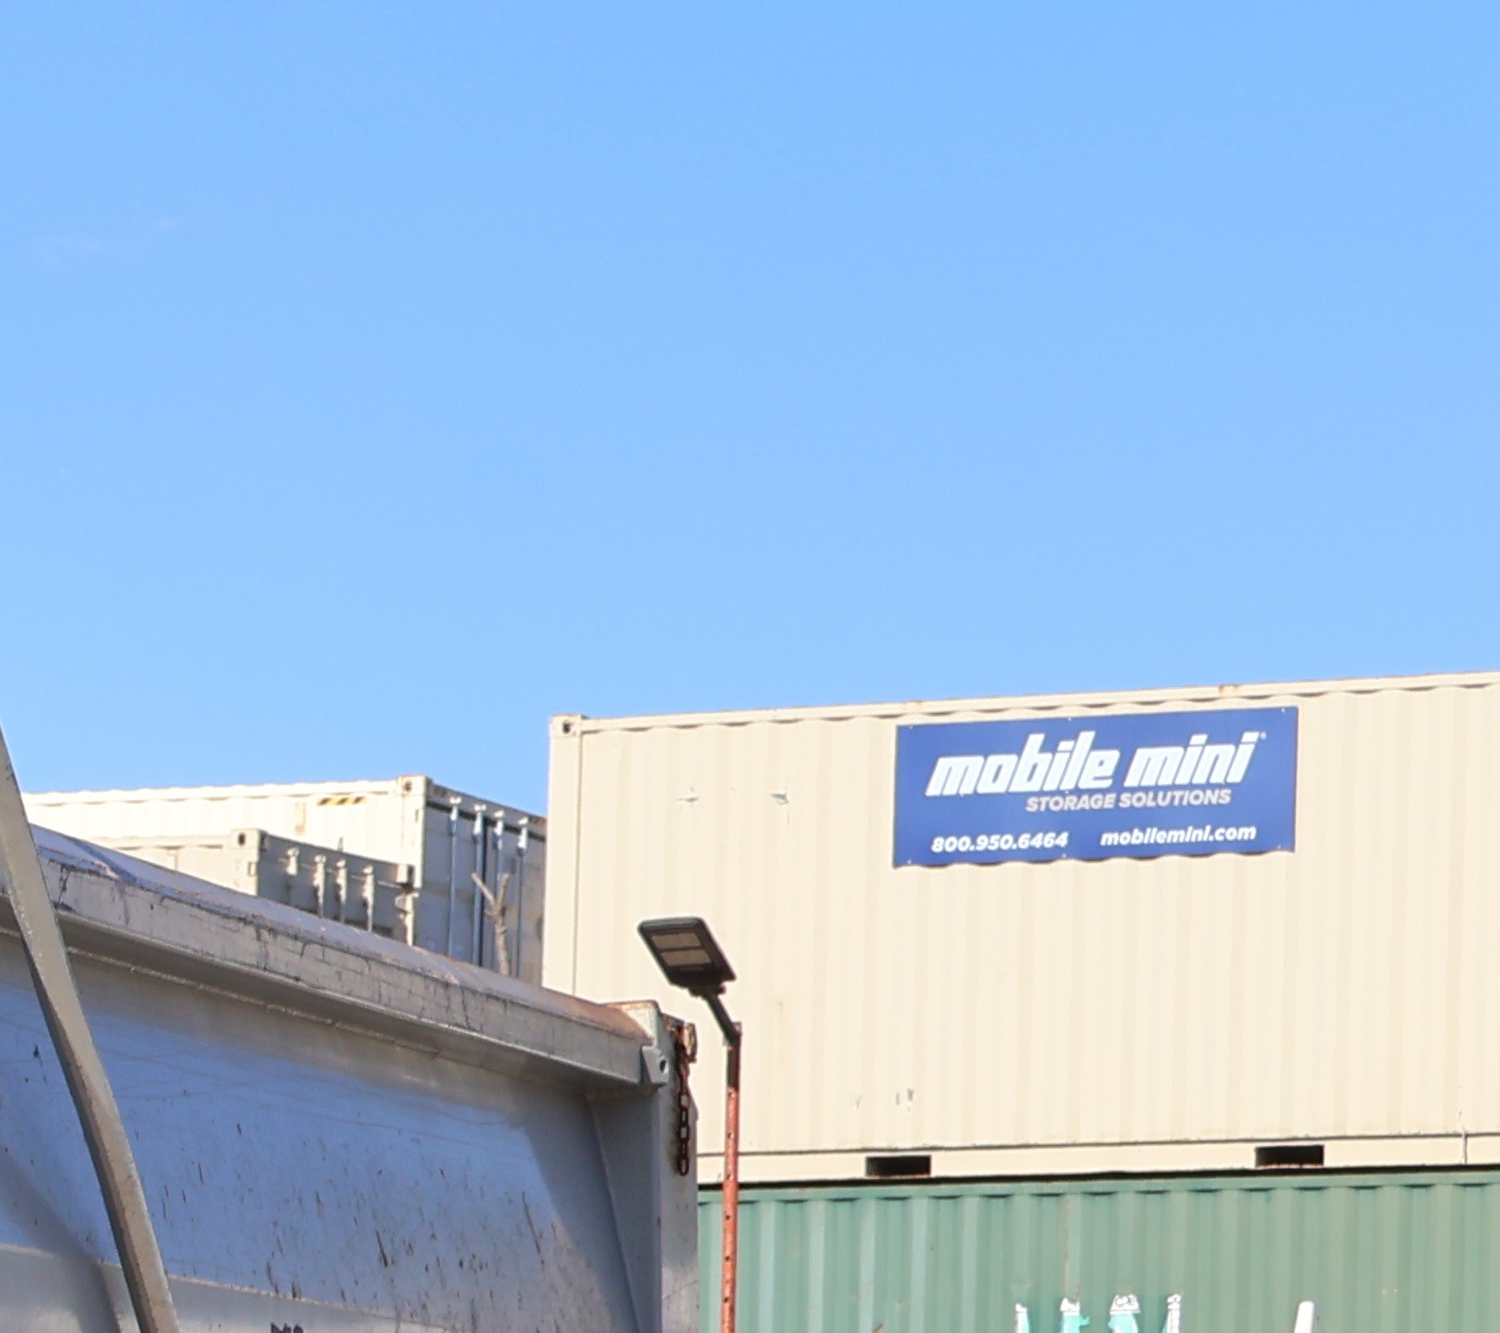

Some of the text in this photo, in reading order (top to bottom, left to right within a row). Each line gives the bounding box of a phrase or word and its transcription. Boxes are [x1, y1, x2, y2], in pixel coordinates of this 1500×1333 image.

[925, 730, 1260, 797] mobile mini
[1025, 788, 1232, 812] STORAGE SOLUTIONS
[930, 824, 1258, 854] 800.950.6464 mobilemini.com
